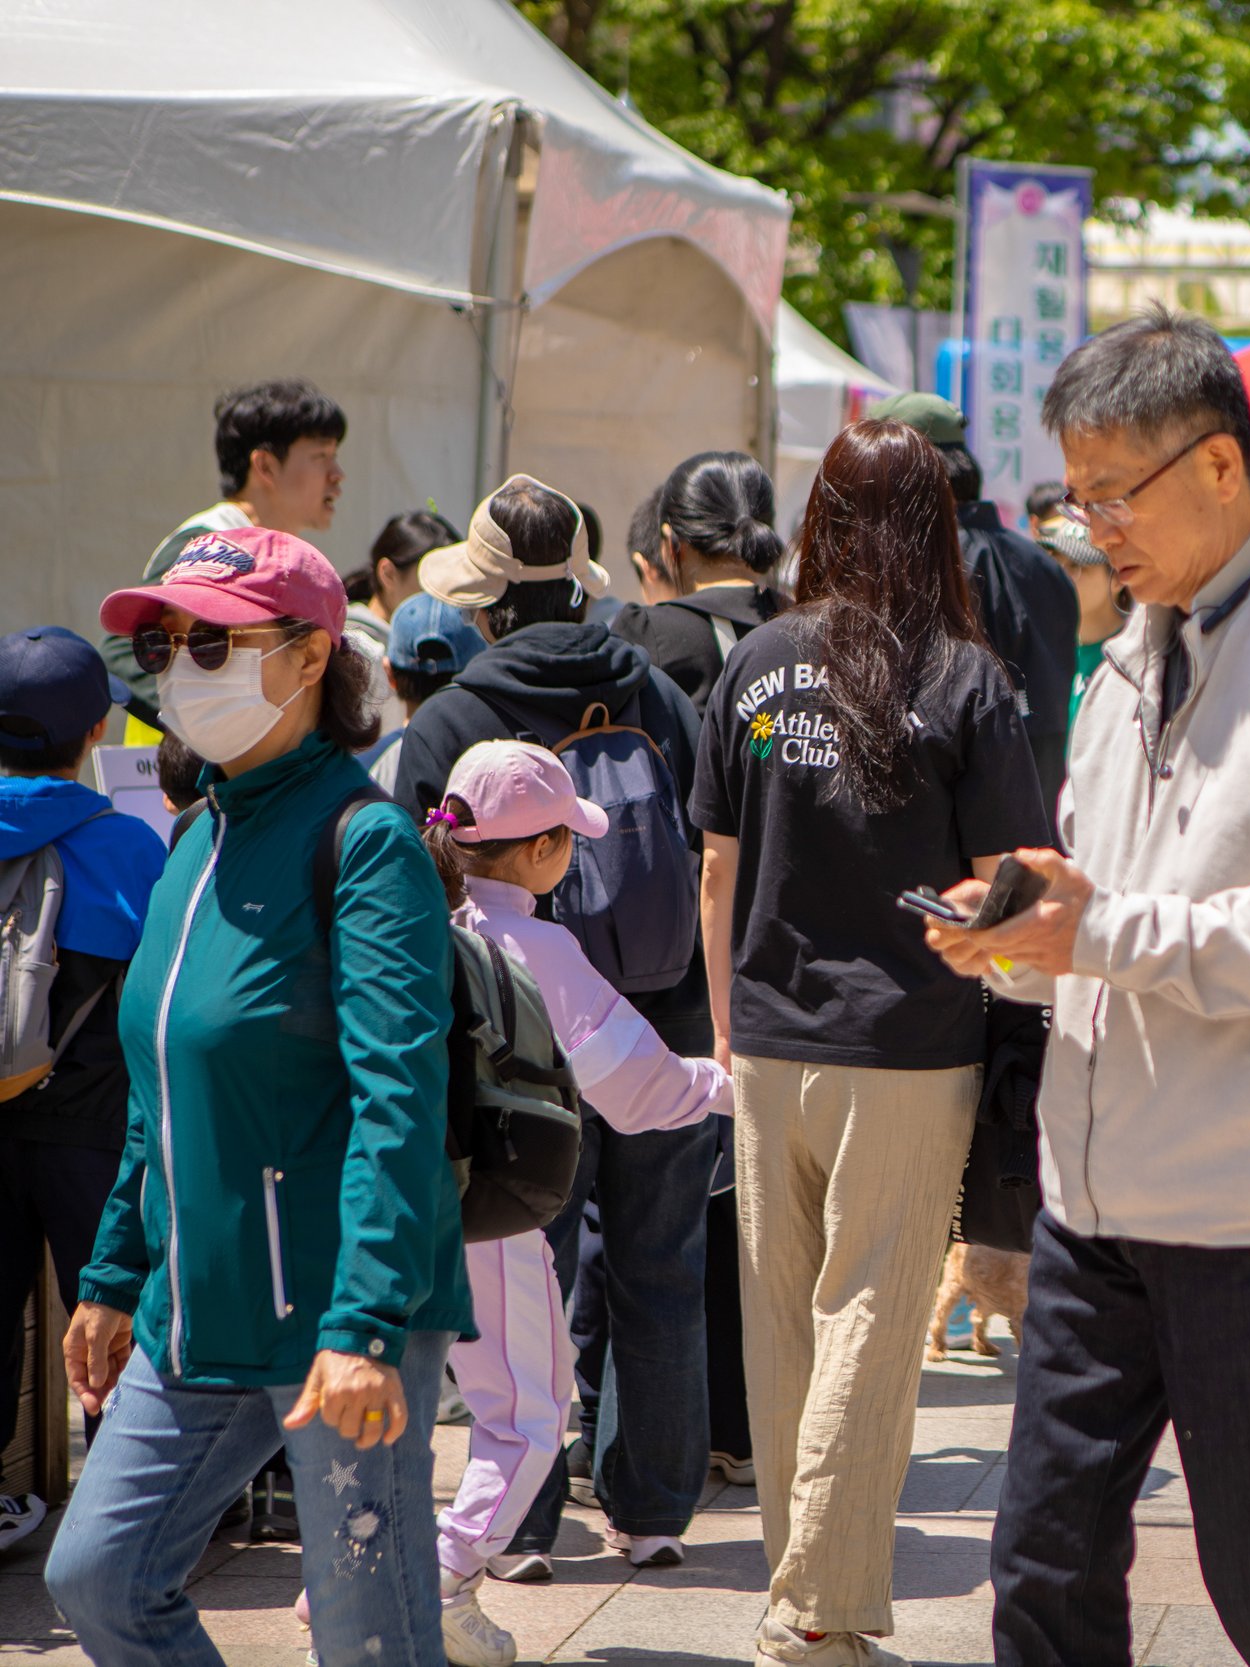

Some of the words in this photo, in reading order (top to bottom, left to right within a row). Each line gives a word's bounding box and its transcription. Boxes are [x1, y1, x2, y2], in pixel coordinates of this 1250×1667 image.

[736, 666, 786, 723] NEW
[793, 663, 830, 690] BA
[781, 738, 840, 770] Club
